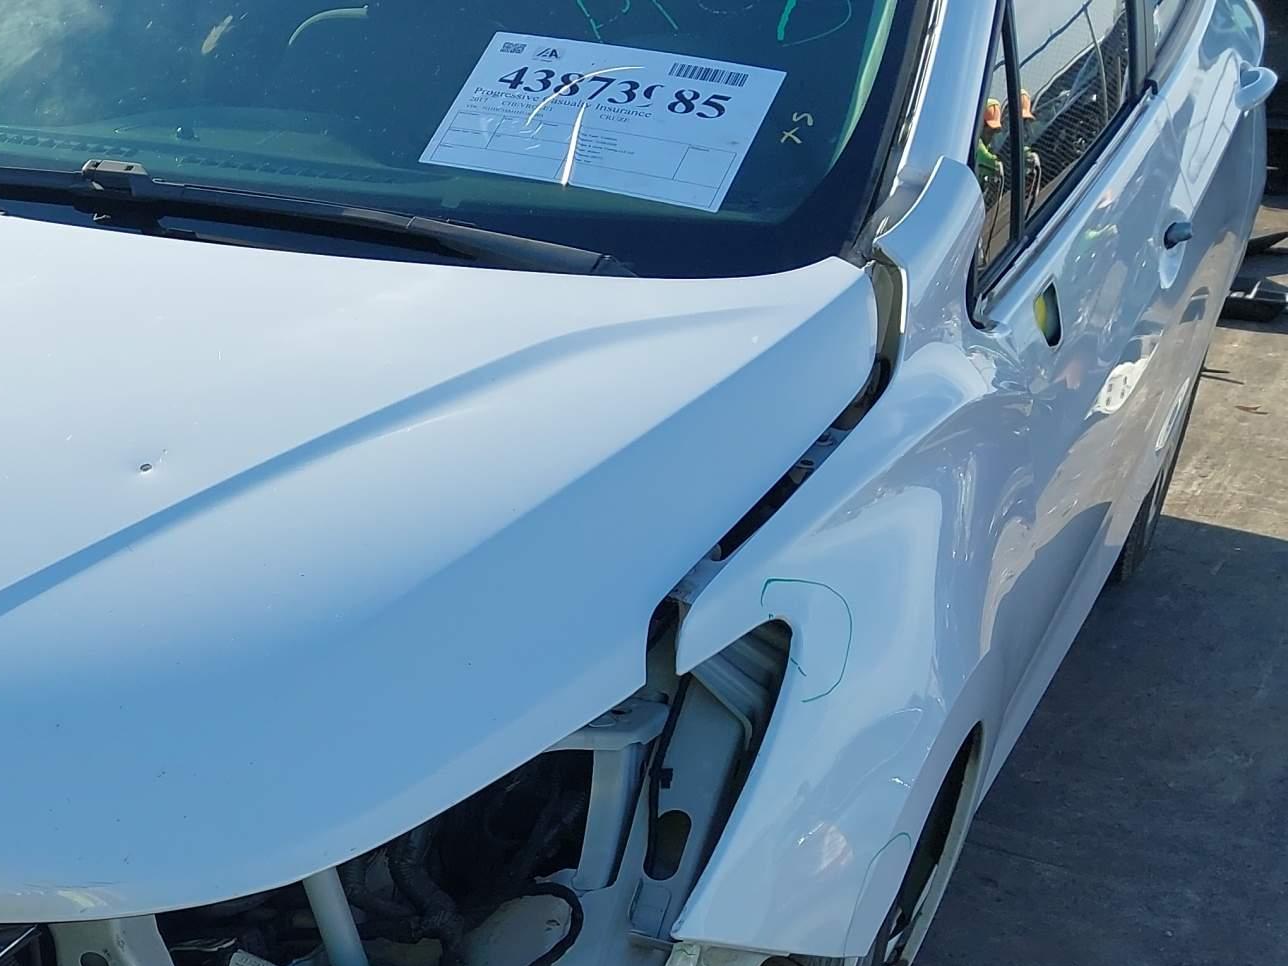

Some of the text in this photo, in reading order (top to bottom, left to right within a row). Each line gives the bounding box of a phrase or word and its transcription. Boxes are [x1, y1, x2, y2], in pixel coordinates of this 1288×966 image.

[473, 87, 540, 102] Progressive
[595, 103, 653, 118] Insurance
[501, 100, 553, 112] CHEVROET
